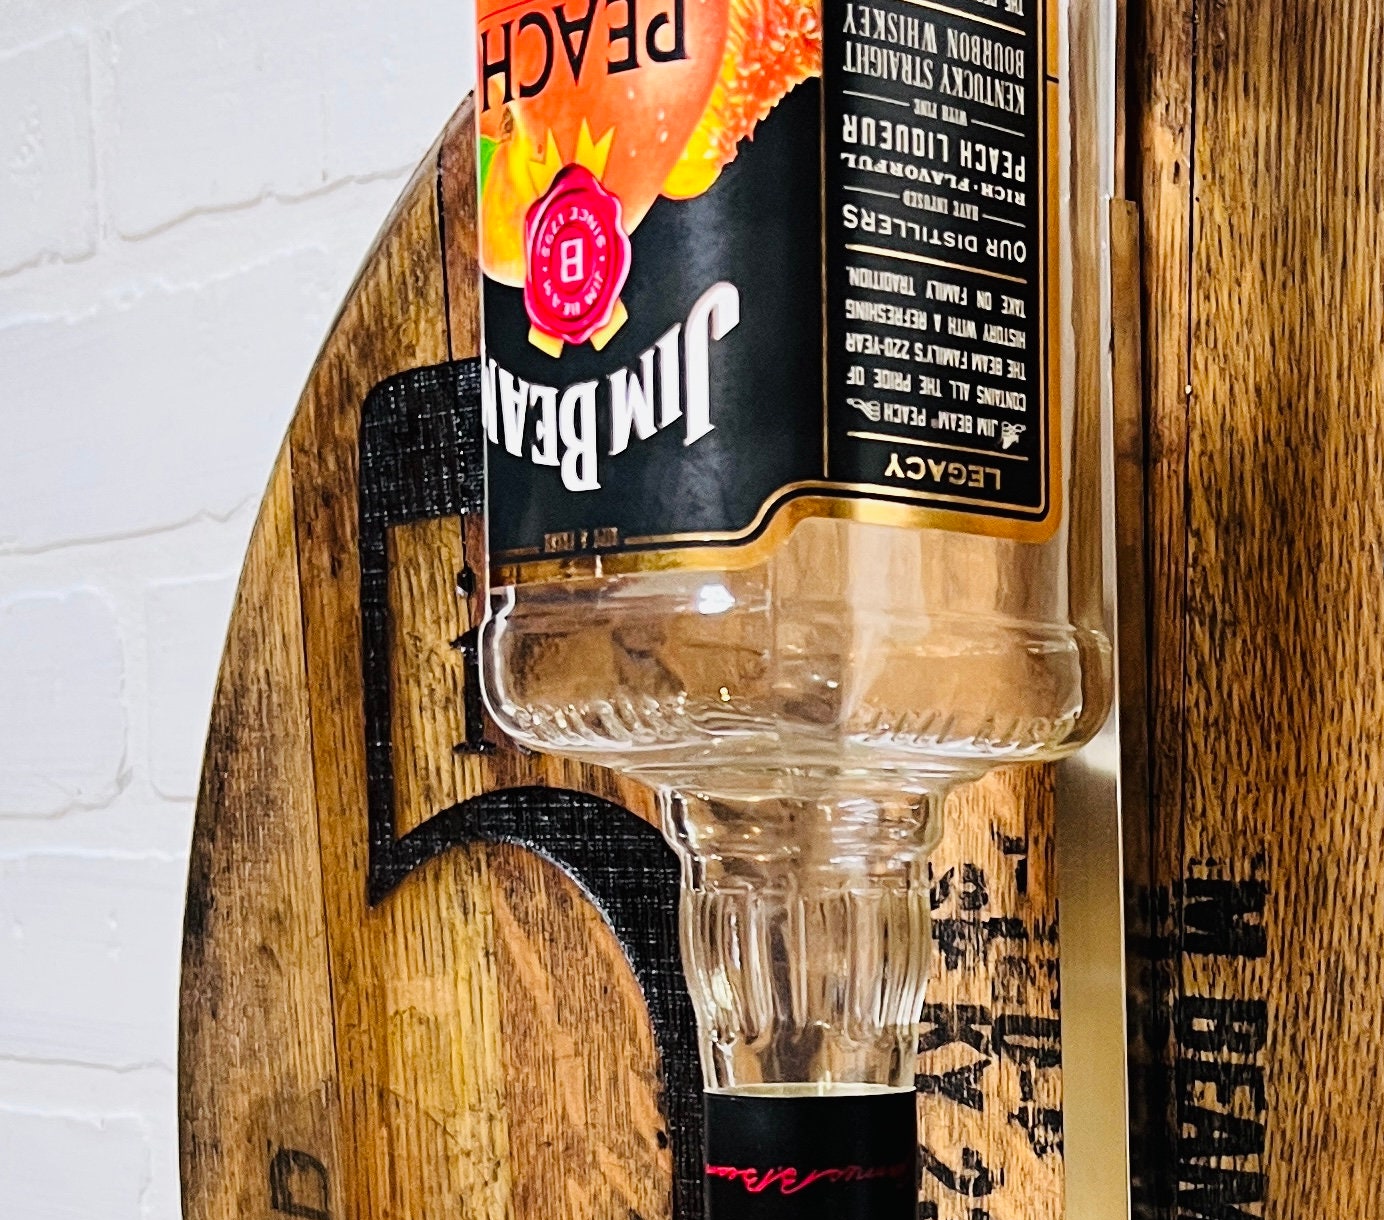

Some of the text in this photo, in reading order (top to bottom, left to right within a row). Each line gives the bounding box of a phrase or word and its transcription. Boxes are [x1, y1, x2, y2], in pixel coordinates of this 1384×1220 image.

[481, 0, 689, 113] PEACH
[842, 3, 1025, 79] BOURBON WHISKEY
[842, 40, 1025, 116] KENTUCKY STRAIGHT
[842, 114, 1026, 183] PEACH LIQUEUR
[569, 206, 607, 248] SINCE
[902, 189, 979, 222] HAVE INFUSED
[842, 203, 1026, 263] OUR DISTILLERS
[560, 238, 584, 284] B
[583, 270, 604, 306] JIM
[846, 266, 1026, 318] TAKE ON FAMILY TRADITION.
[845, 299, 1026, 349] HISTORY WITH A REFRESHING
[607, 280, 740, 456] JIM
[845, 332, 1026, 381] THE BEAM FAMILY'S 220-YEAR
[847, 365, 1026, 412] CONTAINS ALL THE PRIDE OF
[884, 402, 926, 426] PEACH
[977, 417, 998, 437] JIM
[885, 453, 1001, 490] LEGACY
